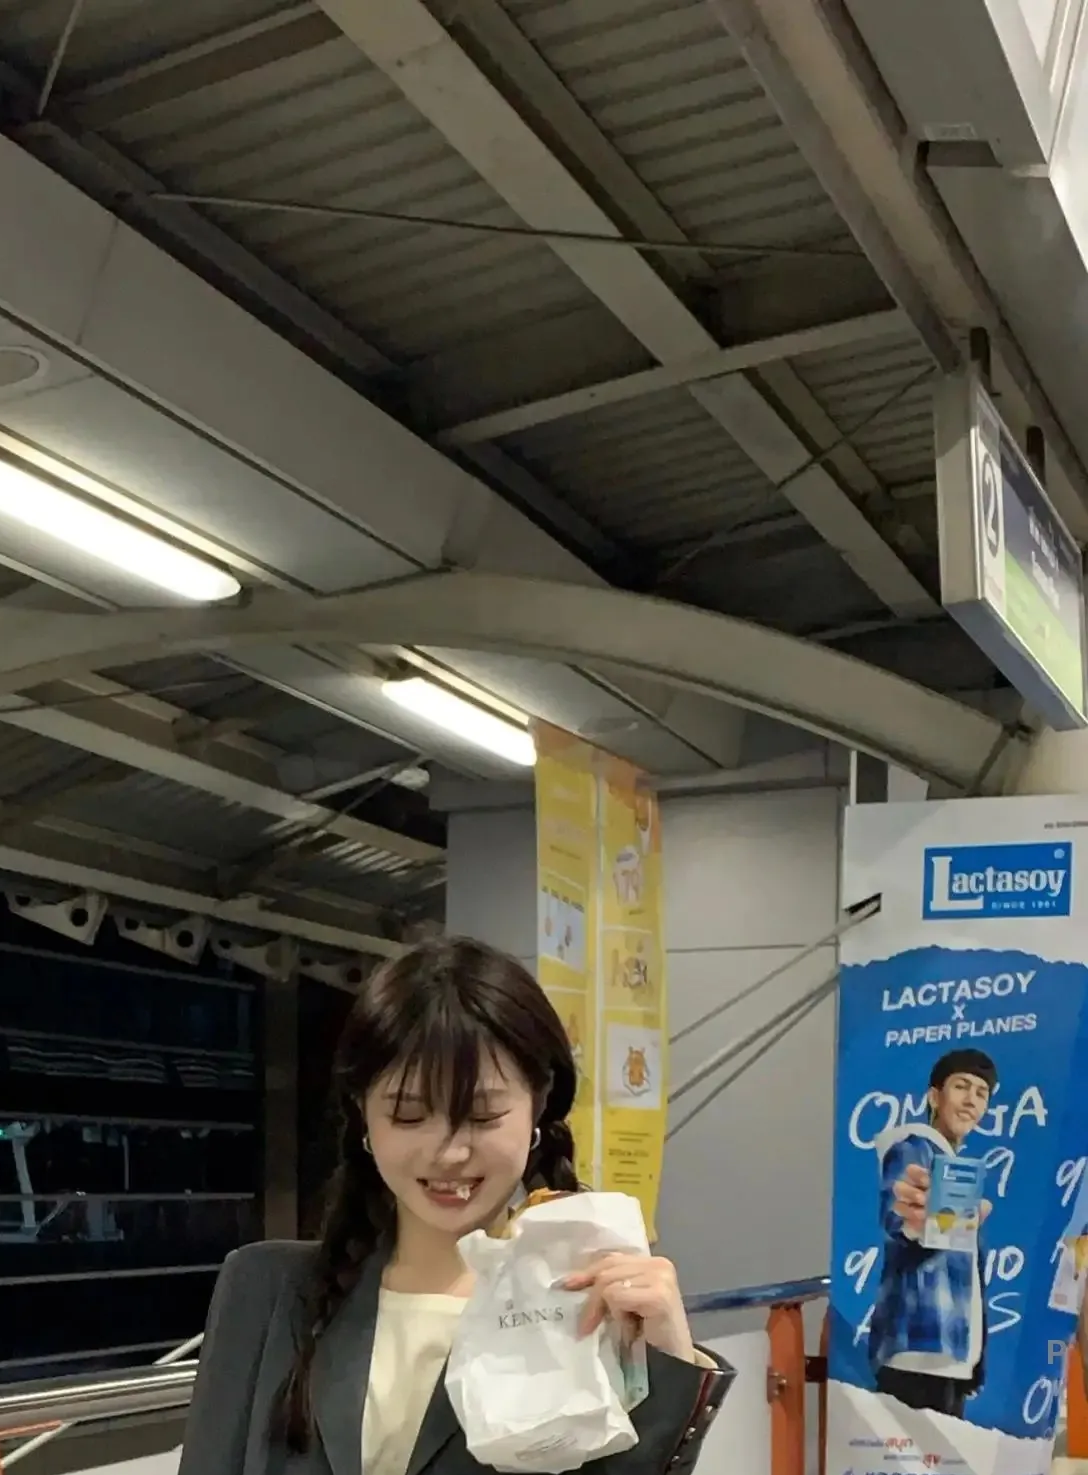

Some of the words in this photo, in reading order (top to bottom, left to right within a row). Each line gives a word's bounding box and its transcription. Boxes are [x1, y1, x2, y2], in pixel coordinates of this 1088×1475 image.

[930, 856, 1066, 911] Lactasoy
[882, 970, 1036, 1012] LACTASOY
[885, 1024, 952, 1048] PAPER
[957, 1013, 1037, 1039] PLANES
